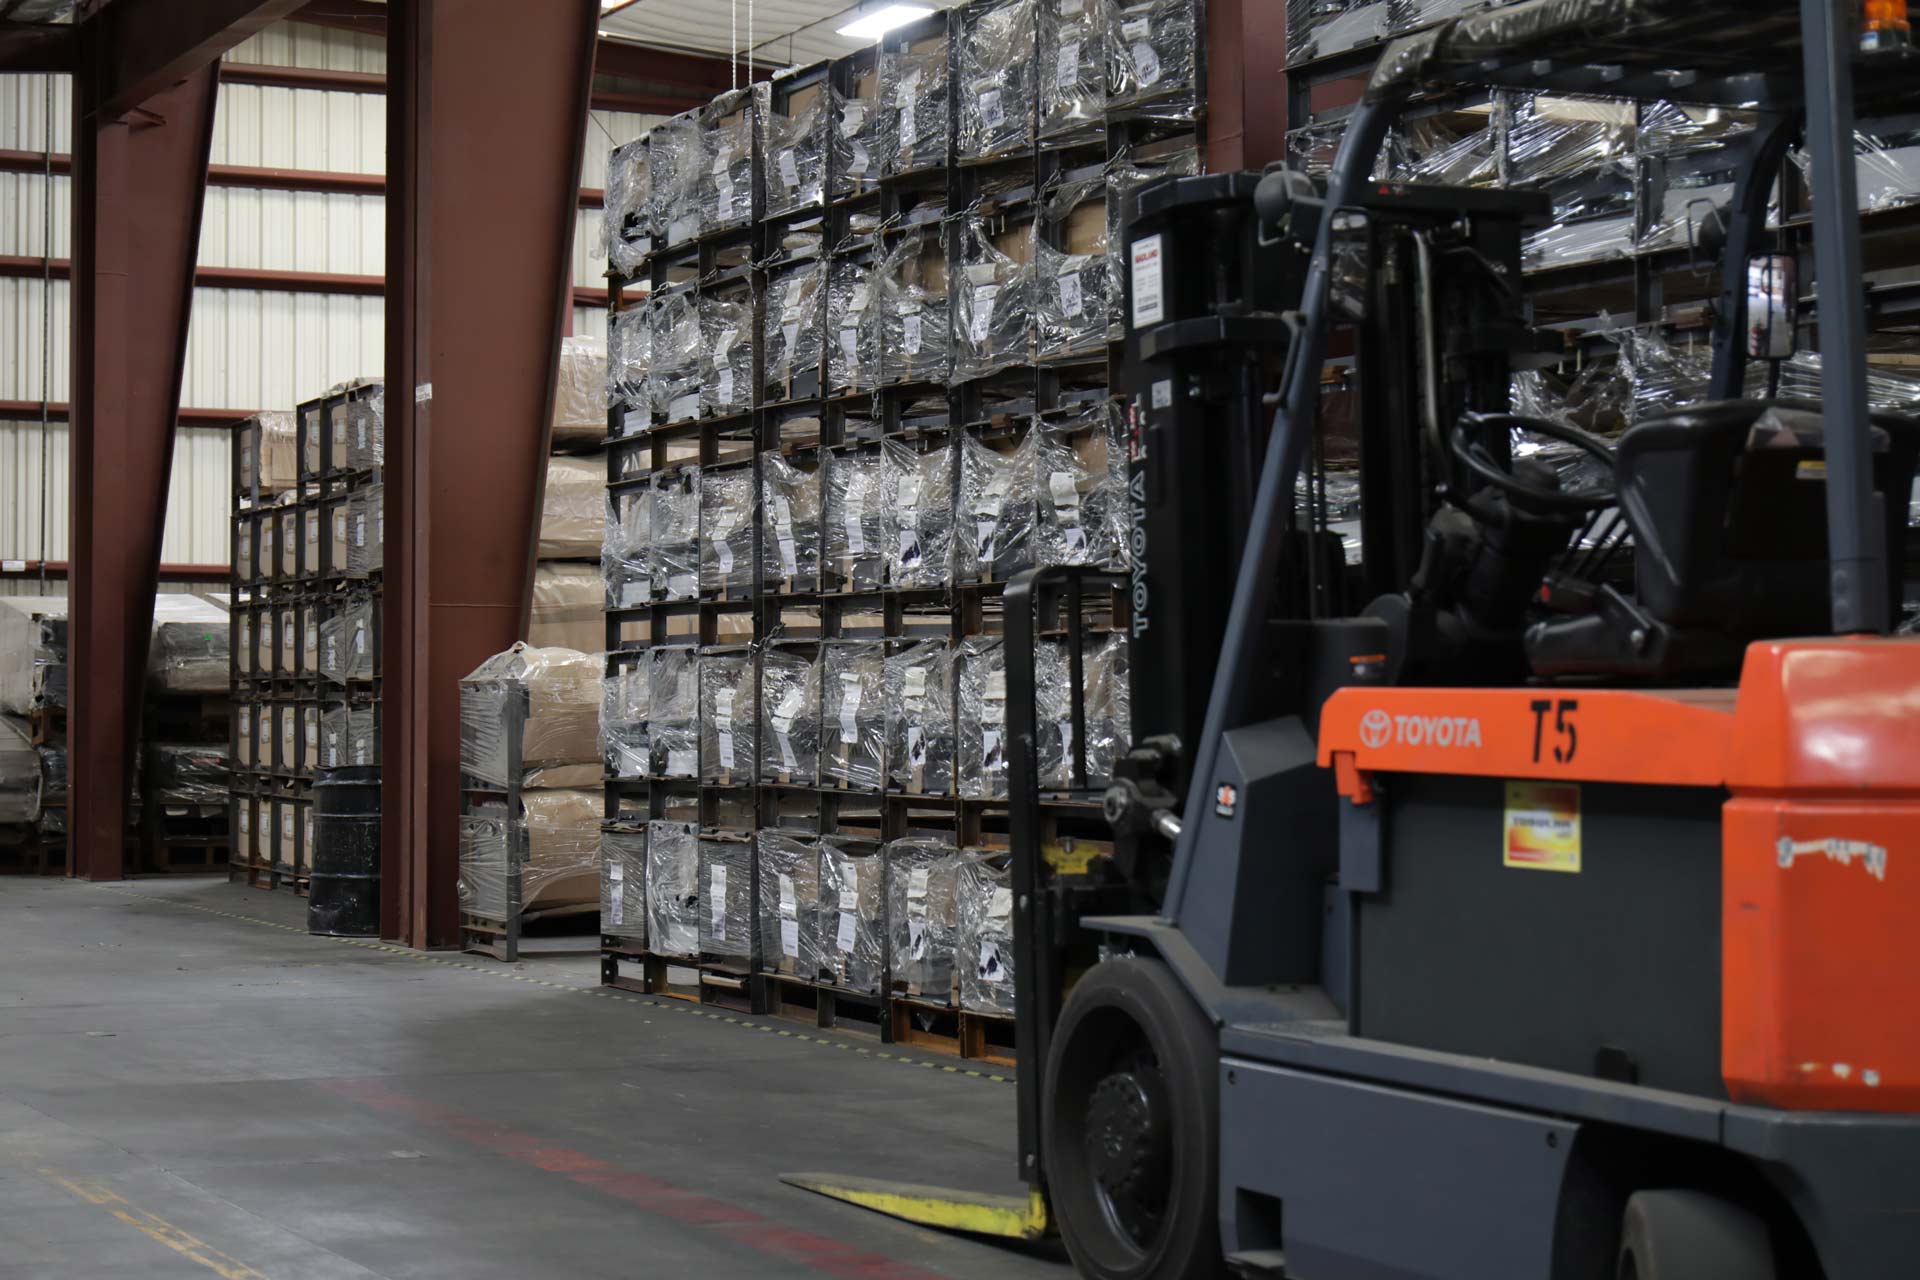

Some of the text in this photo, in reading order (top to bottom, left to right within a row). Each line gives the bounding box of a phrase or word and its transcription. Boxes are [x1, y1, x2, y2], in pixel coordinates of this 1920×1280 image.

[1130, 470, 1148, 638] TOYOTA
[1395, 715, 1482, 748] TOYOTA
[1530, 699, 1578, 764] T5
